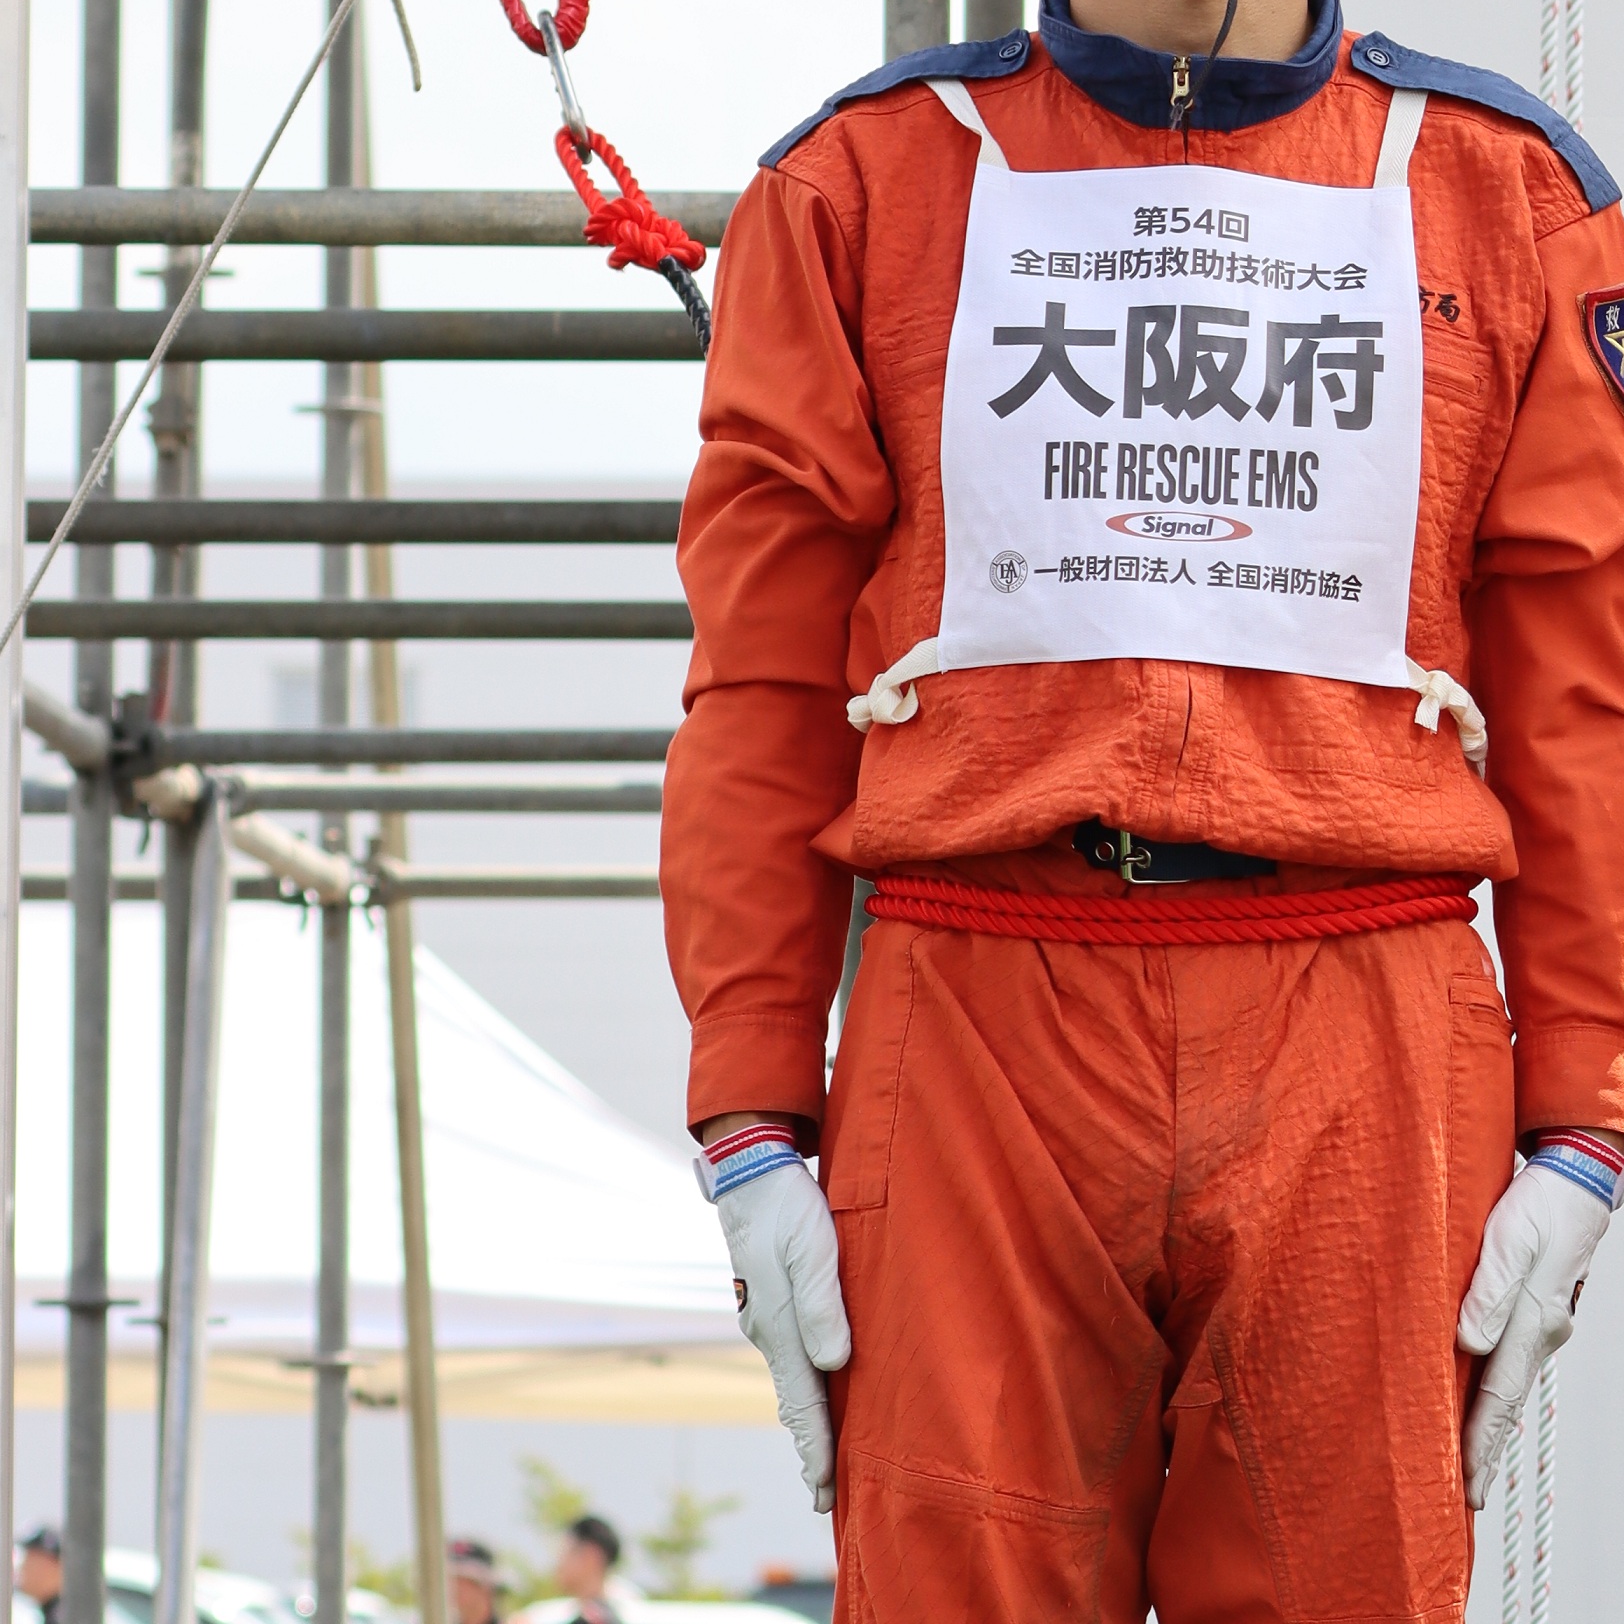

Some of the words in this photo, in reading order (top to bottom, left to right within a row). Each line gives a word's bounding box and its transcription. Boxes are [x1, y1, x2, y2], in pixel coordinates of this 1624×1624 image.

[1132, 206, 1250, 243] 第54回
[1009, 247, 1369, 292] 全国消防救助技術大会
[986, 300, 1385, 431] 大阪府
[1044, 441, 1109, 500] FIRE
[1116, 442, 1240, 506] RESCUE
[1247, 448, 1319, 512] EMS
[1141, 515, 1214, 538] Signal
[1033, 555, 1197, 586] 一般財団法人
[1206, 560, 1363, 603] 全国消防協会
